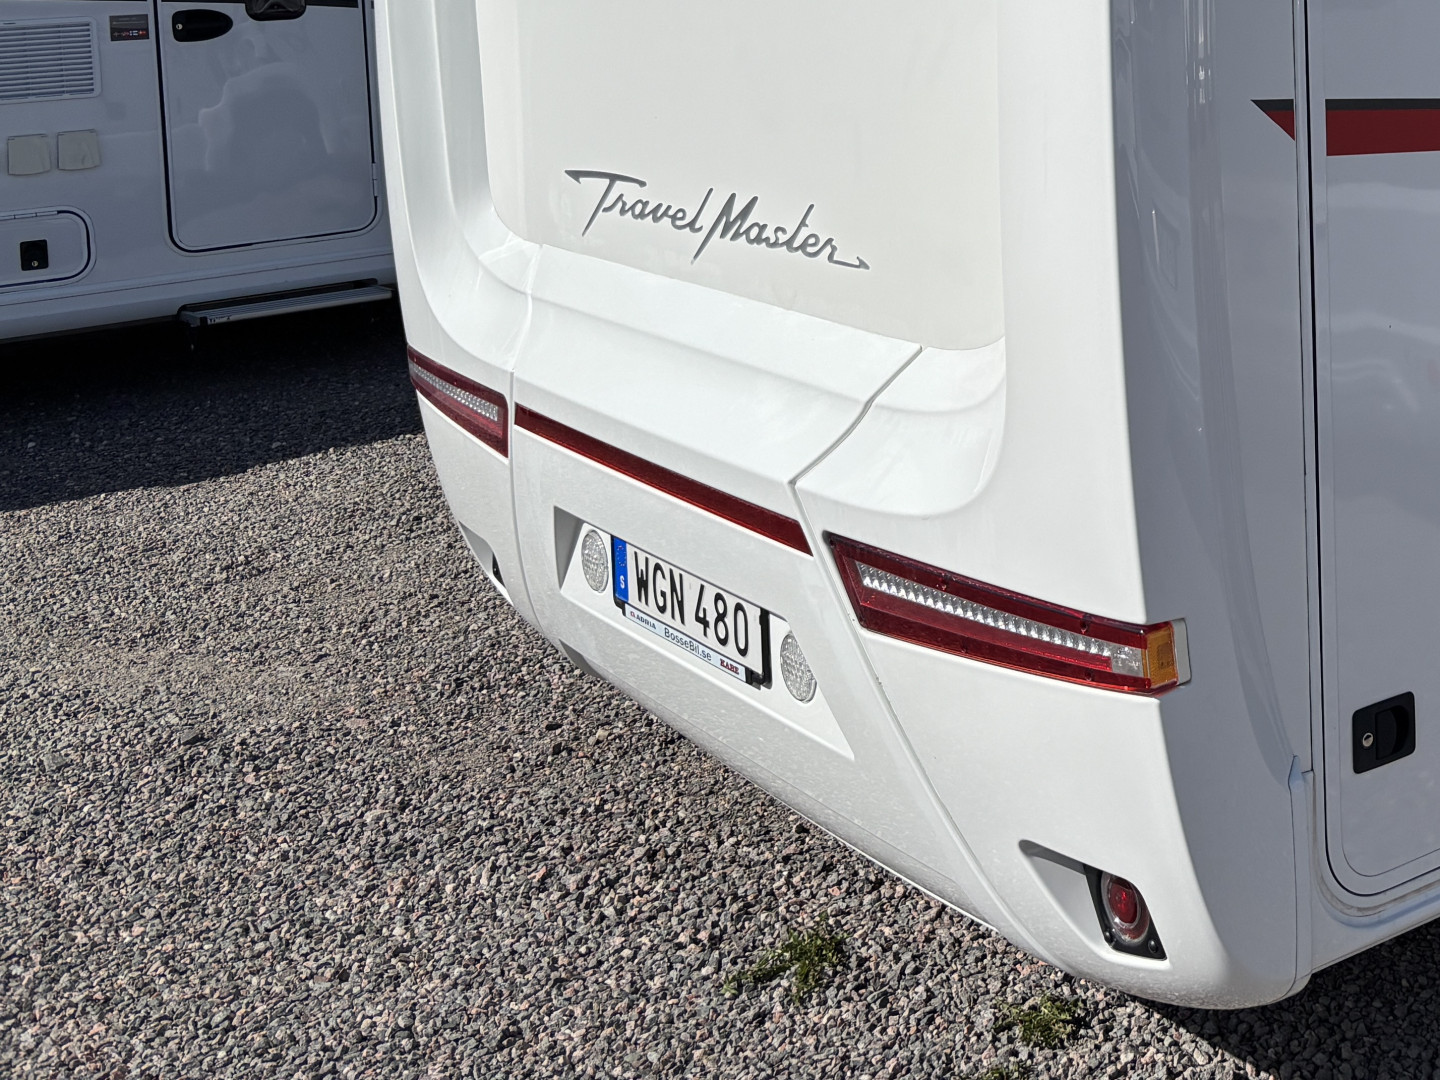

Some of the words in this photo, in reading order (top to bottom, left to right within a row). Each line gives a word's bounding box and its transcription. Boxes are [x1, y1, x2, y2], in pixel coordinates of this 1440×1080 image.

[564, 169, 714, 237] Travel
[690, 192, 871, 271] Master
[619, 574, 626, 590] S
[633, 550, 686, 626] WGN
[694, 584, 749, 657] 480
[636, 613, 657, 629] ADRIA
[664, 626, 712, 661] BosseBil.se
[719, 658, 740, 675] KABE
